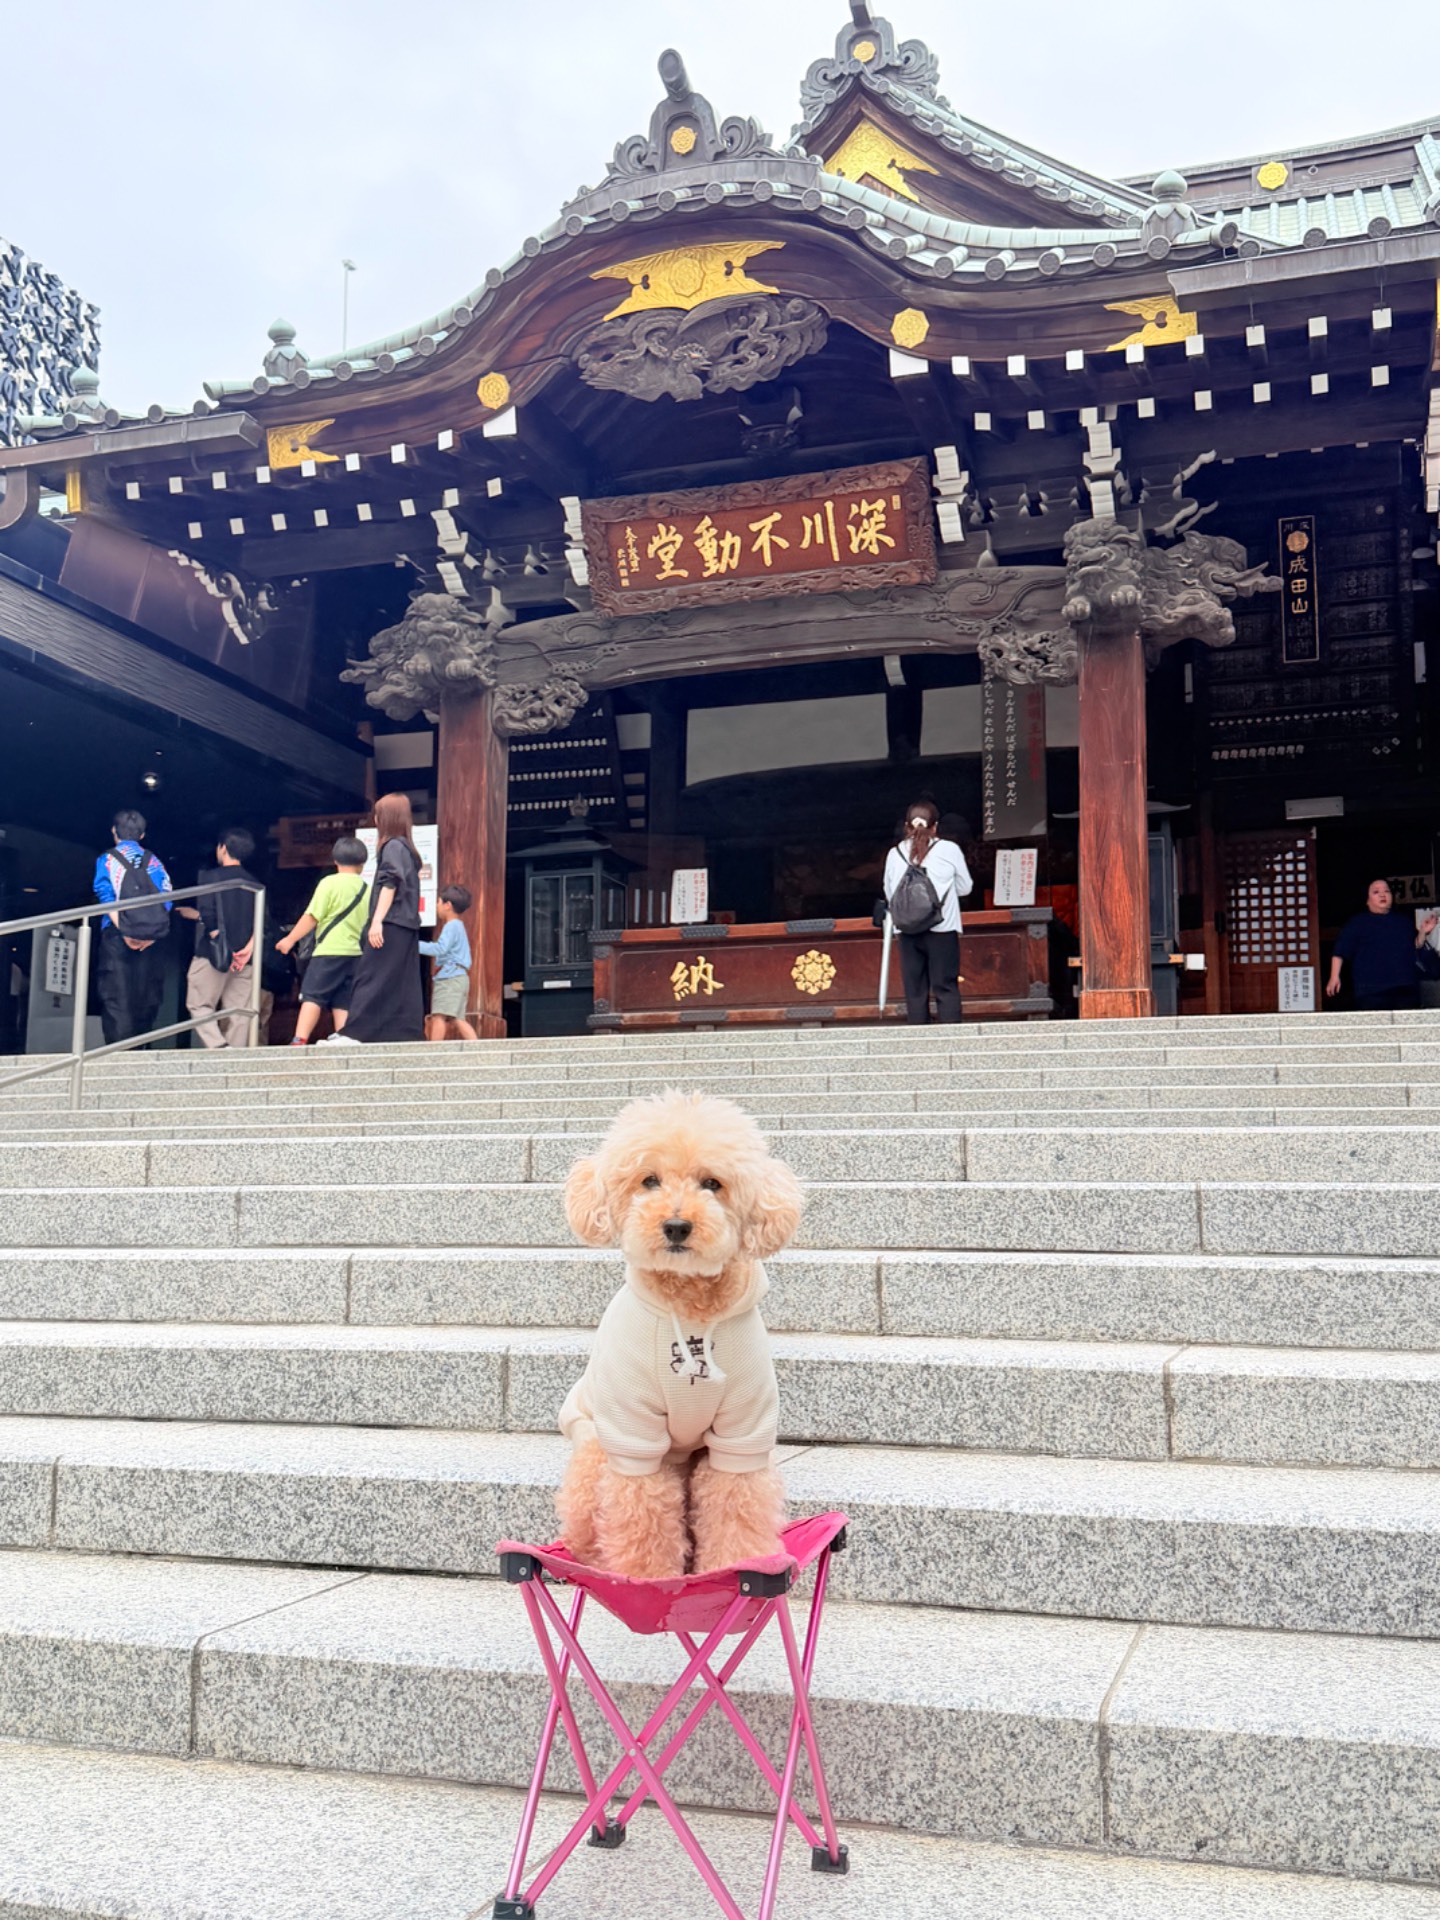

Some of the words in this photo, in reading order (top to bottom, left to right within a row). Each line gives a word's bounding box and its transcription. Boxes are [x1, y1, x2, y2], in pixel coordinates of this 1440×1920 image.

[647, 498, 896, 581] 深川不動堂
[1288, 555, 1310, 614] 成田山
[670, 955, 724, 1002] 納
